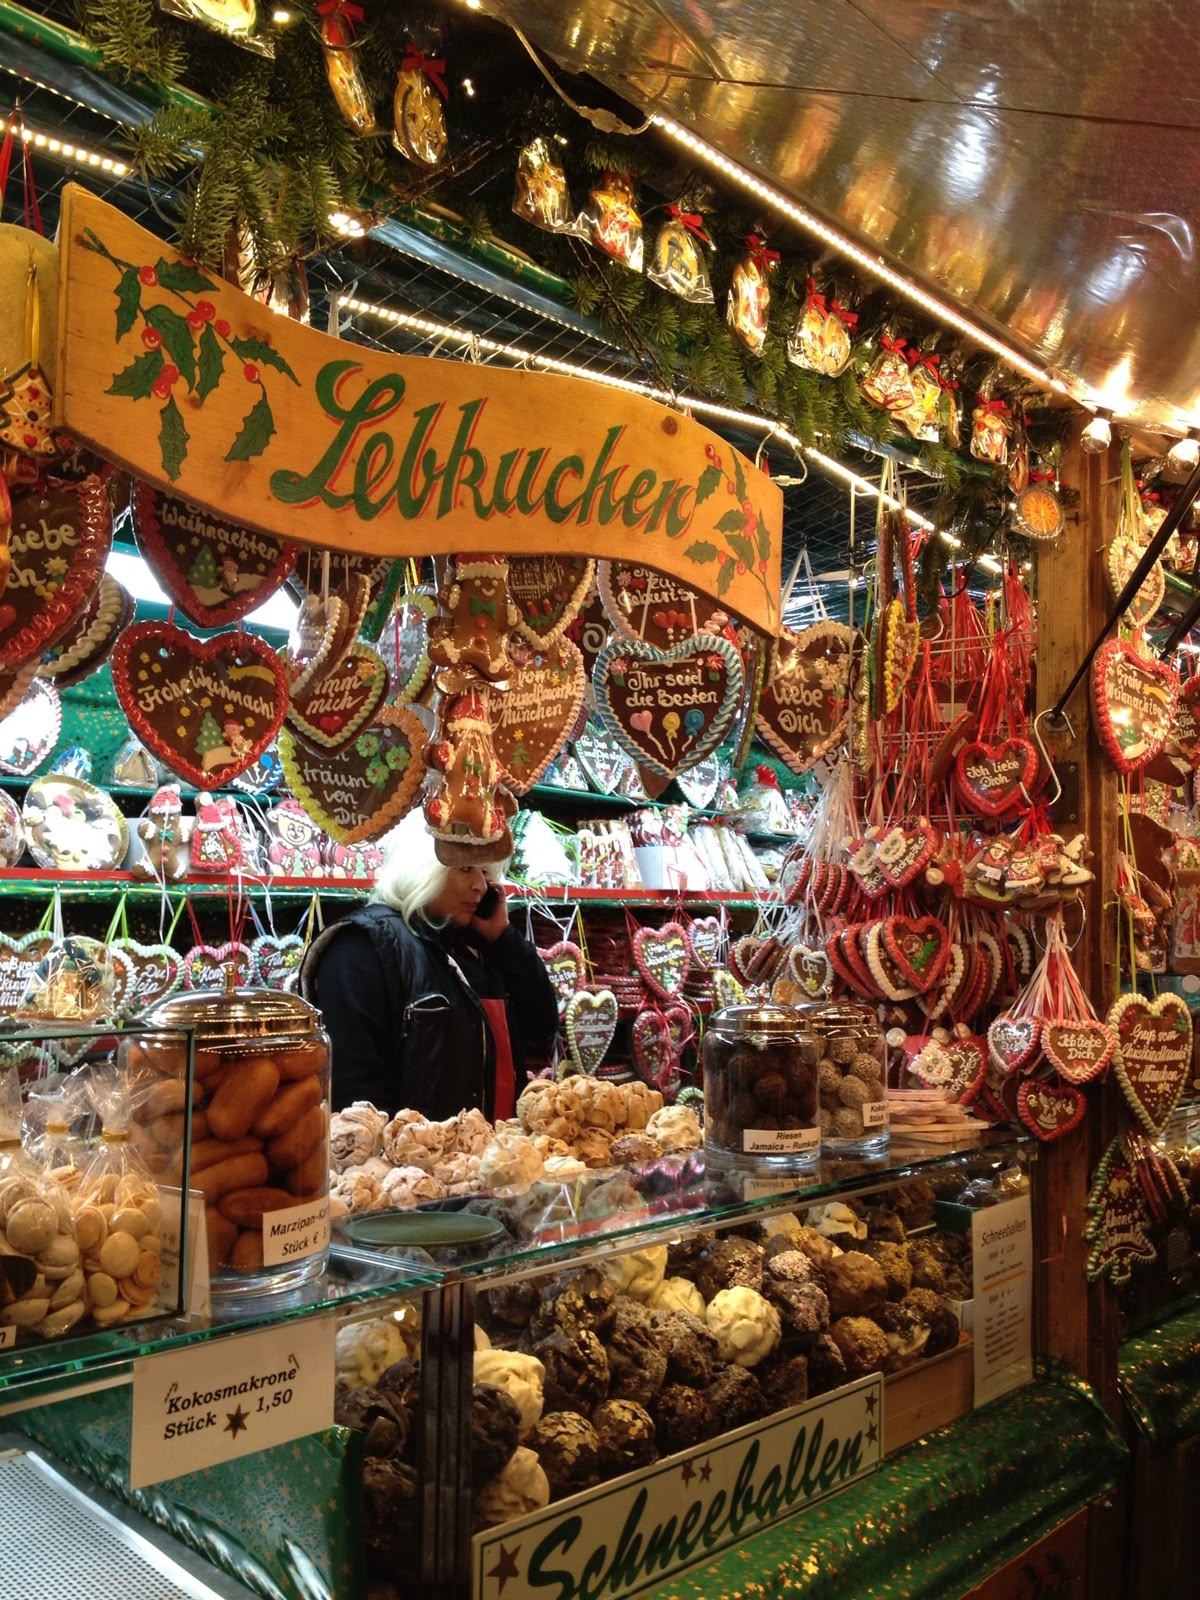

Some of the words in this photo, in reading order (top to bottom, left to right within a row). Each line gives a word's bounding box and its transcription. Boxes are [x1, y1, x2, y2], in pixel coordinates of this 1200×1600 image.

[269, 359, 698, 540] Lebkuchen
[9, 519, 81, 554] iebe
[157, 502, 279, 561] Weihnachten
[627, 670, 662, 691] Ihr
[664, 668, 704, 687] seid
[137, 678, 192, 713] Frohe
[306, 690, 365, 715] mich
[625, 691, 656, 708] die
[656, 687, 719, 708] Besten
[777, 707, 829, 736] Dich
[303, 761, 371, 789] träum
[966, 764, 991, 779] Ich
[980, 773, 1011, 788] Dich
[323, 789, 359, 805] von
[333, 804, 371, 826] Dir
[1057, 1033, 1076, 1048] Ich
[1066, 1046, 1096, 1060] Dich
[749, 1142, 785, 1151] Jamaica
[776, 1131, 803, 1141] Riesen
[281, 1238, 309, 1257] Stück
[165, 1367, 298, 1416] Kokosmakrone
[163, 1411, 218, 1441] Stück
[254, 1387, 294, 1414] 1,50
[526, 1417, 865, 1600] Schneeballen
